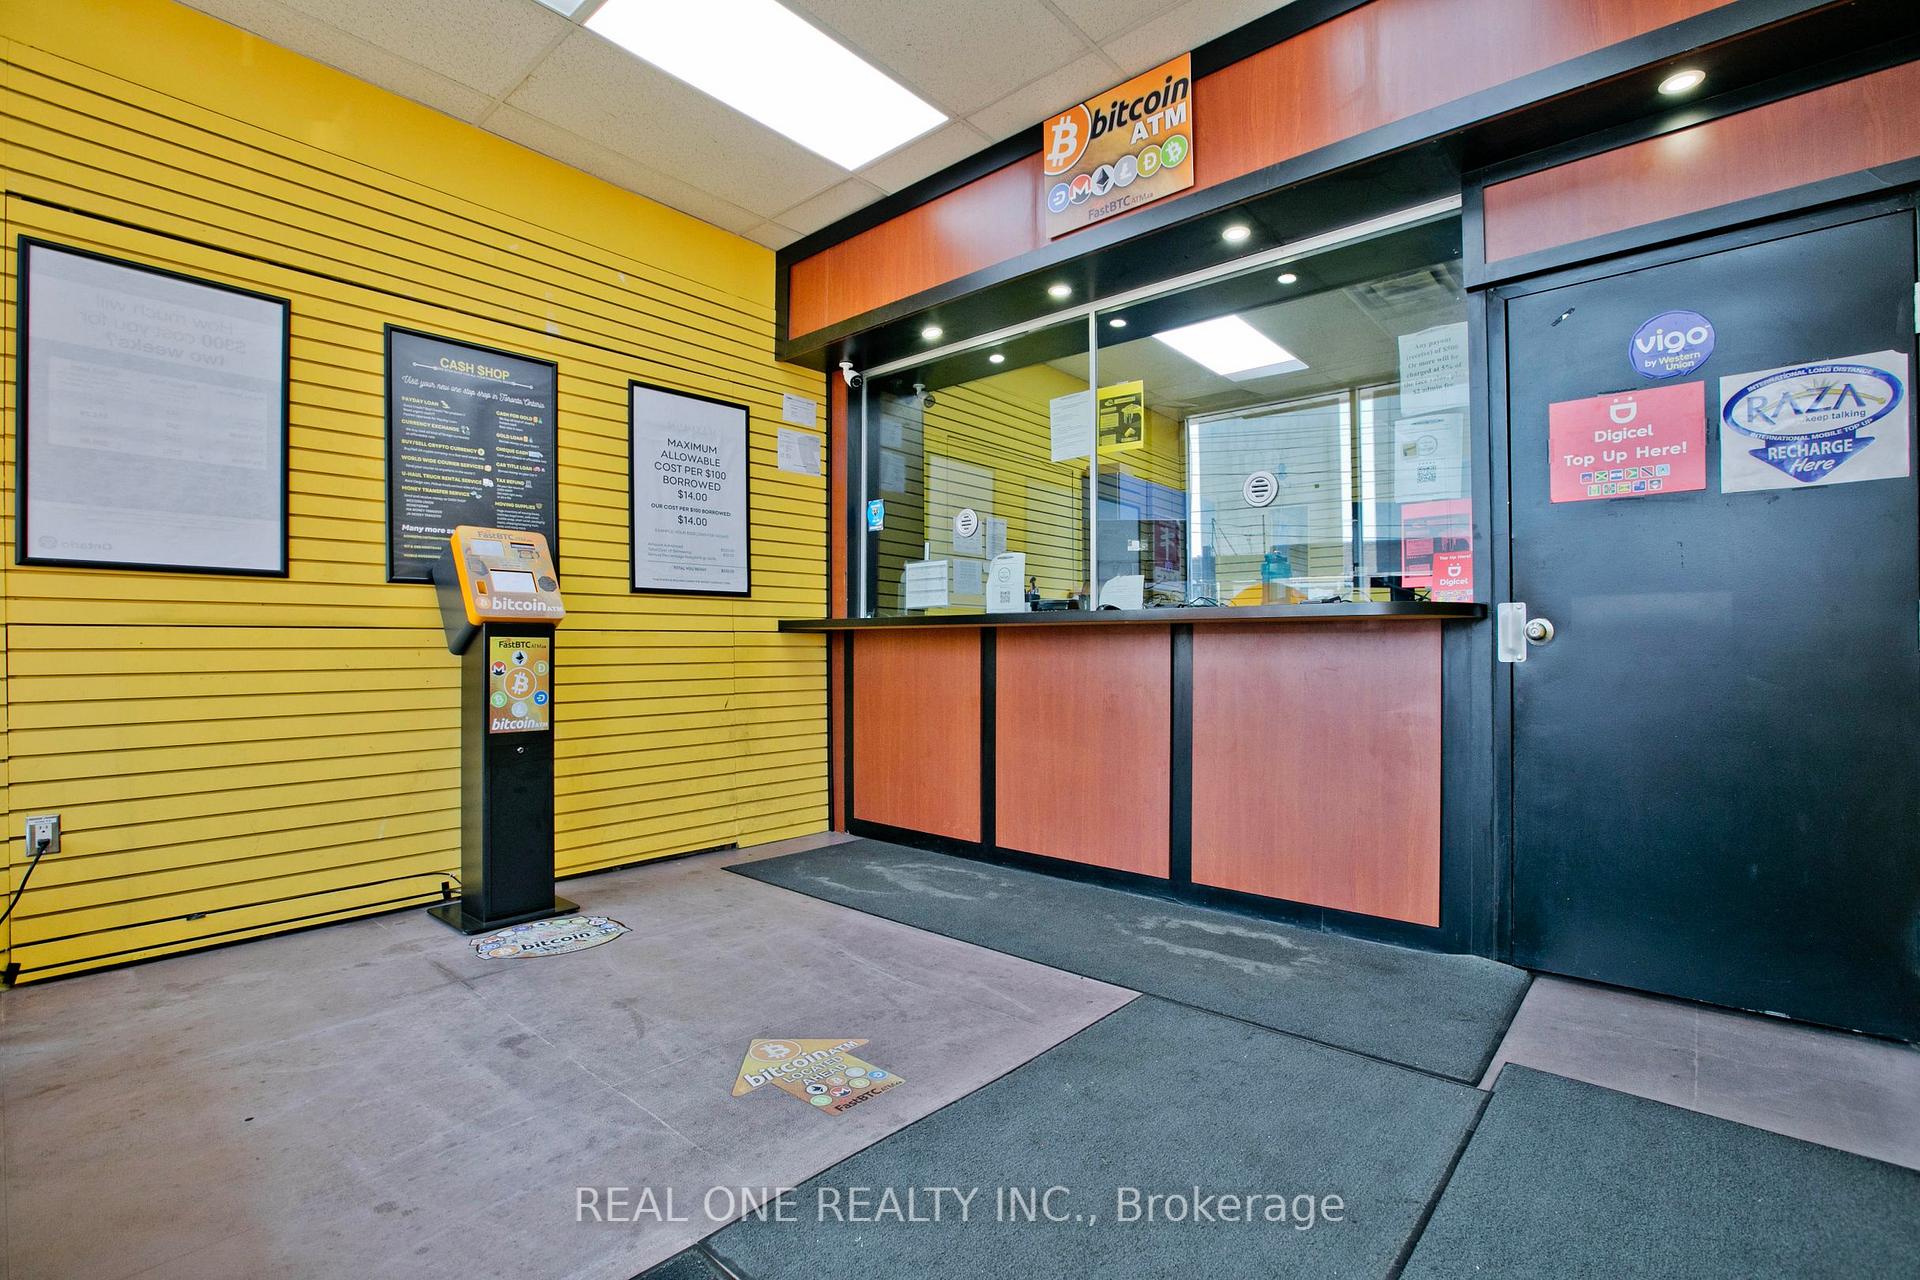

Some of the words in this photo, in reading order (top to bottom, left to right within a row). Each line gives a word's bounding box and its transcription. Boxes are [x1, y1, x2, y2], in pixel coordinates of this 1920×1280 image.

[1090, 75, 1189, 138] bitcoin
[1130, 102, 1186, 144] ATM
[1635, 325, 1709, 354] vigo
[440, 358, 474, 374] CASH
[477, 364, 510, 380] SHOP
[1644, 359, 1658, 368] by
[1659, 351, 1700, 364] Western
[1666, 360, 1695, 371] Union
[1747, 369, 1808, 392] INTERNATIONAL
[1808, 366, 1832, 374] LONG
[1832, 364, 1874, 375] DISTANCE
[1746, 383, 1866, 425] RAZA
[1832, 409, 1866, 421] talking
[1594, 424, 1654, 444] Digicel
[1750, 432, 1810, 442] INTERNATIONAL
[1812, 428, 1842, 440] MOBILE
[1844, 424, 1860, 432] TOP
[1860, 418, 1873, 427] UP
[667, 438, 718, 454] MAXIMUM
[1564, 454, 1596, 468] Top
[1602, 450, 1628, 464] Up
[1636, 441, 1688, 459] Here!
[1768, 438, 1853, 460] RECHARGE
[660, 450, 720, 468] ALLOWABLE
[1790, 457, 1836, 473] Here
[654, 461, 682, 475] COST
[684, 465, 702, 477] PER
[705, 468, 727, 480] $100
[662, 475, 721, 492] BORROWED
[677, 490, 708, 502] $14.00
[401, 524, 424, 534] Many
[424, 526, 446, 534] more
[678, 514, 708, 526] $14.00
[478, 530, 512, 540] FastBTC
[1440, 578, 1468, 586] Digicel
[492, 596, 547, 611] bitcoin
[498, 640, 531, 649] FastBTC
[492, 716, 536, 730] bitcoin
[521, 931, 590, 950] bitcoin
[744, 1048, 828, 1088] bitcoin
[827, 1040, 859, 1056] ATM
[782, 1056, 844, 1083] LOCATED
[802, 1064, 848, 1086] AHEAD
[834, 1088, 882, 1112] FastBTC
